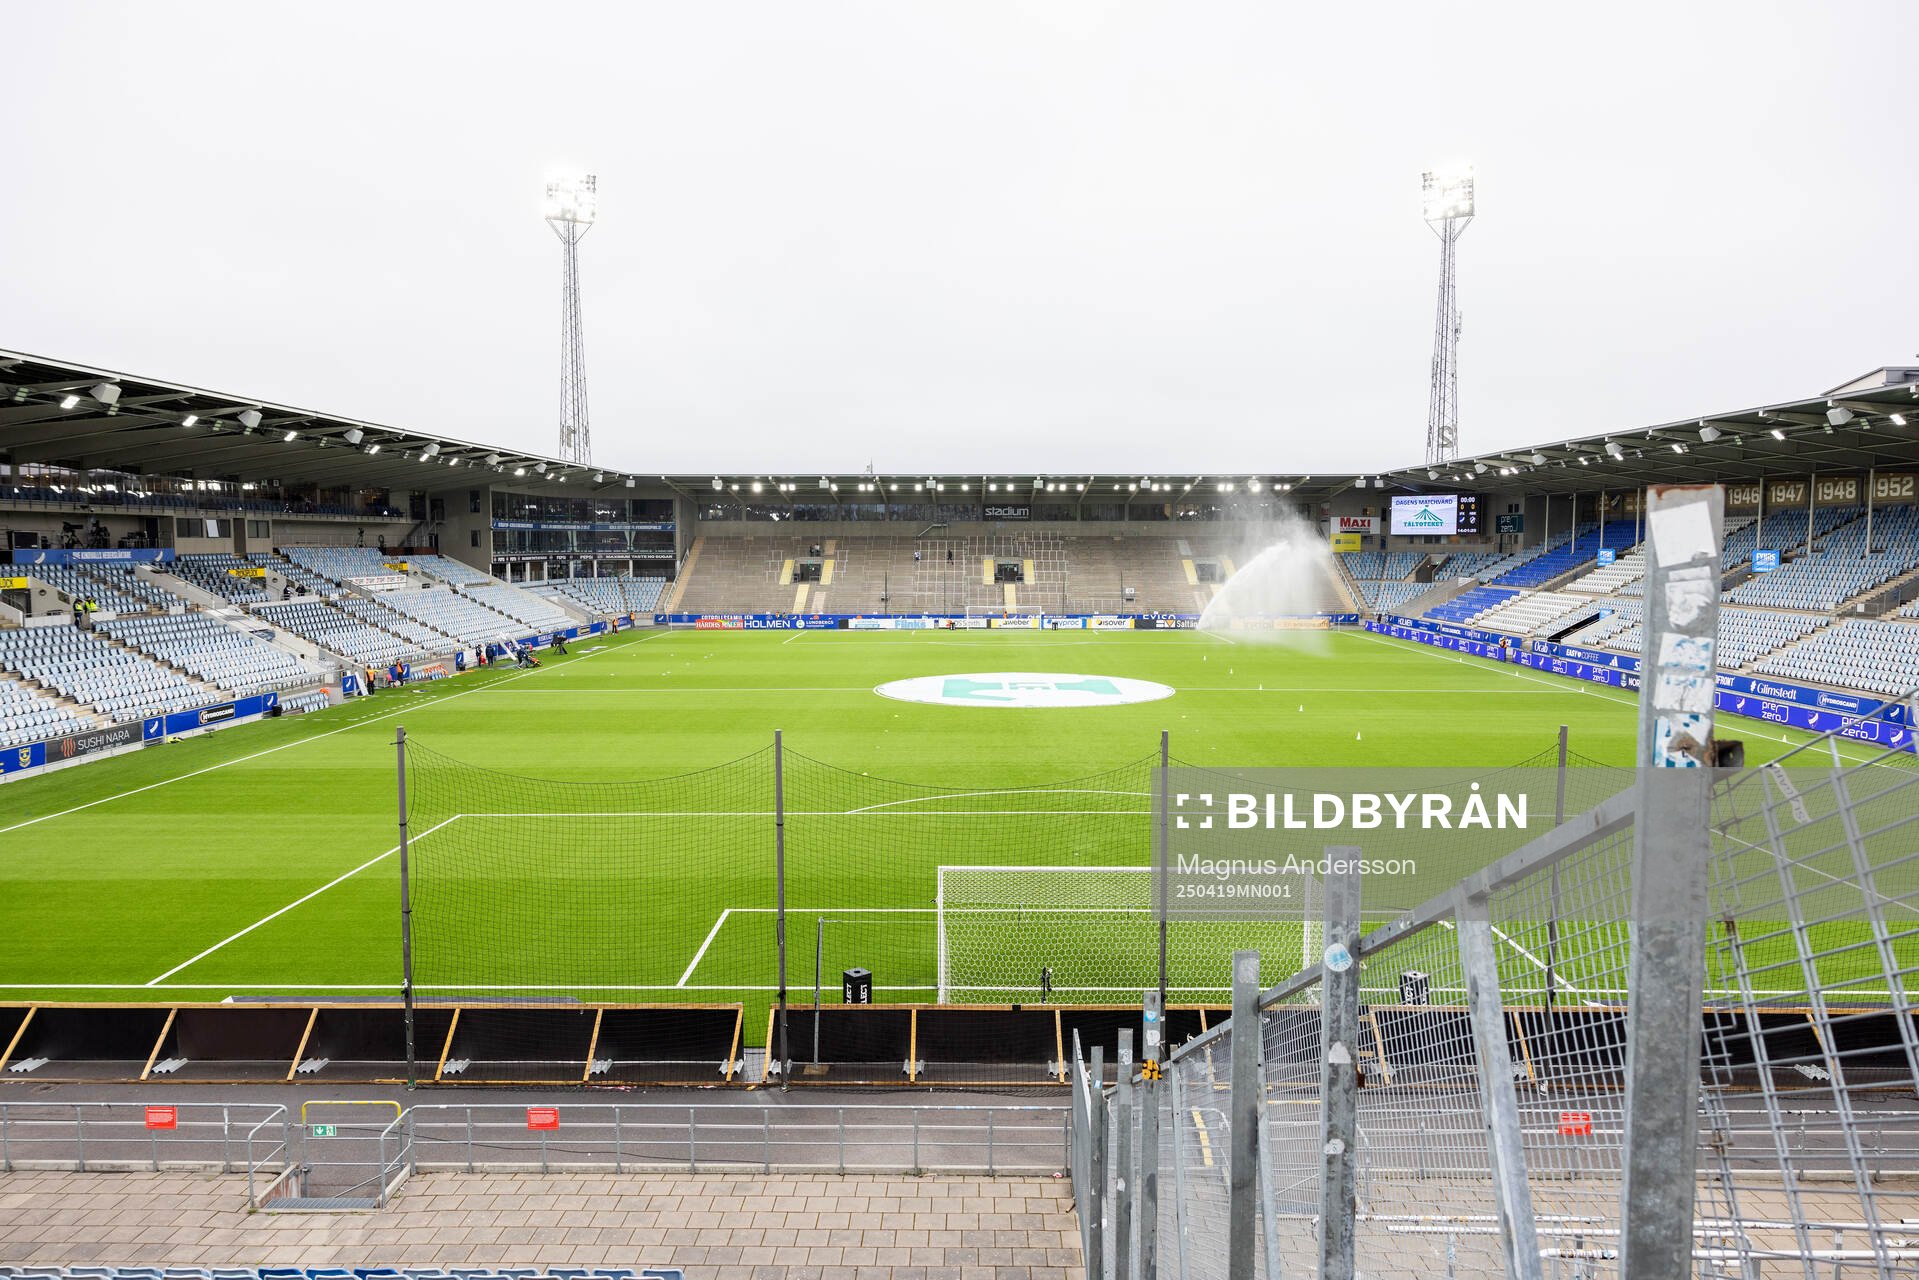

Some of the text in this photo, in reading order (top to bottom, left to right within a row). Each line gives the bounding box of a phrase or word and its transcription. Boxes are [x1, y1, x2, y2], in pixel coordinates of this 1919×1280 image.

[1728, 487, 1760, 505] 1946
[1770, 483, 1805, 503] 1947
[1816, 480, 1857, 500] 1948
[985, 506, 1029, 517] stadium
[744, 620, 791, 628] HOLMEN
[1534, 641, 1549, 654] Ocab
[1565, 648, 1600, 662] EASY COFFEE
[1592, 666, 1604, 675] pre
[1592, 674, 1605, 682] zero
[1757, 682, 1797, 700] Glimstedt
[1761, 701, 1777, 711] pre
[1761, 711, 1781, 722] zero
[1841, 727, 1869, 739] zero
[78, 735, 104, 750] SUSHI
[105, 729, 130, 744] NARA
